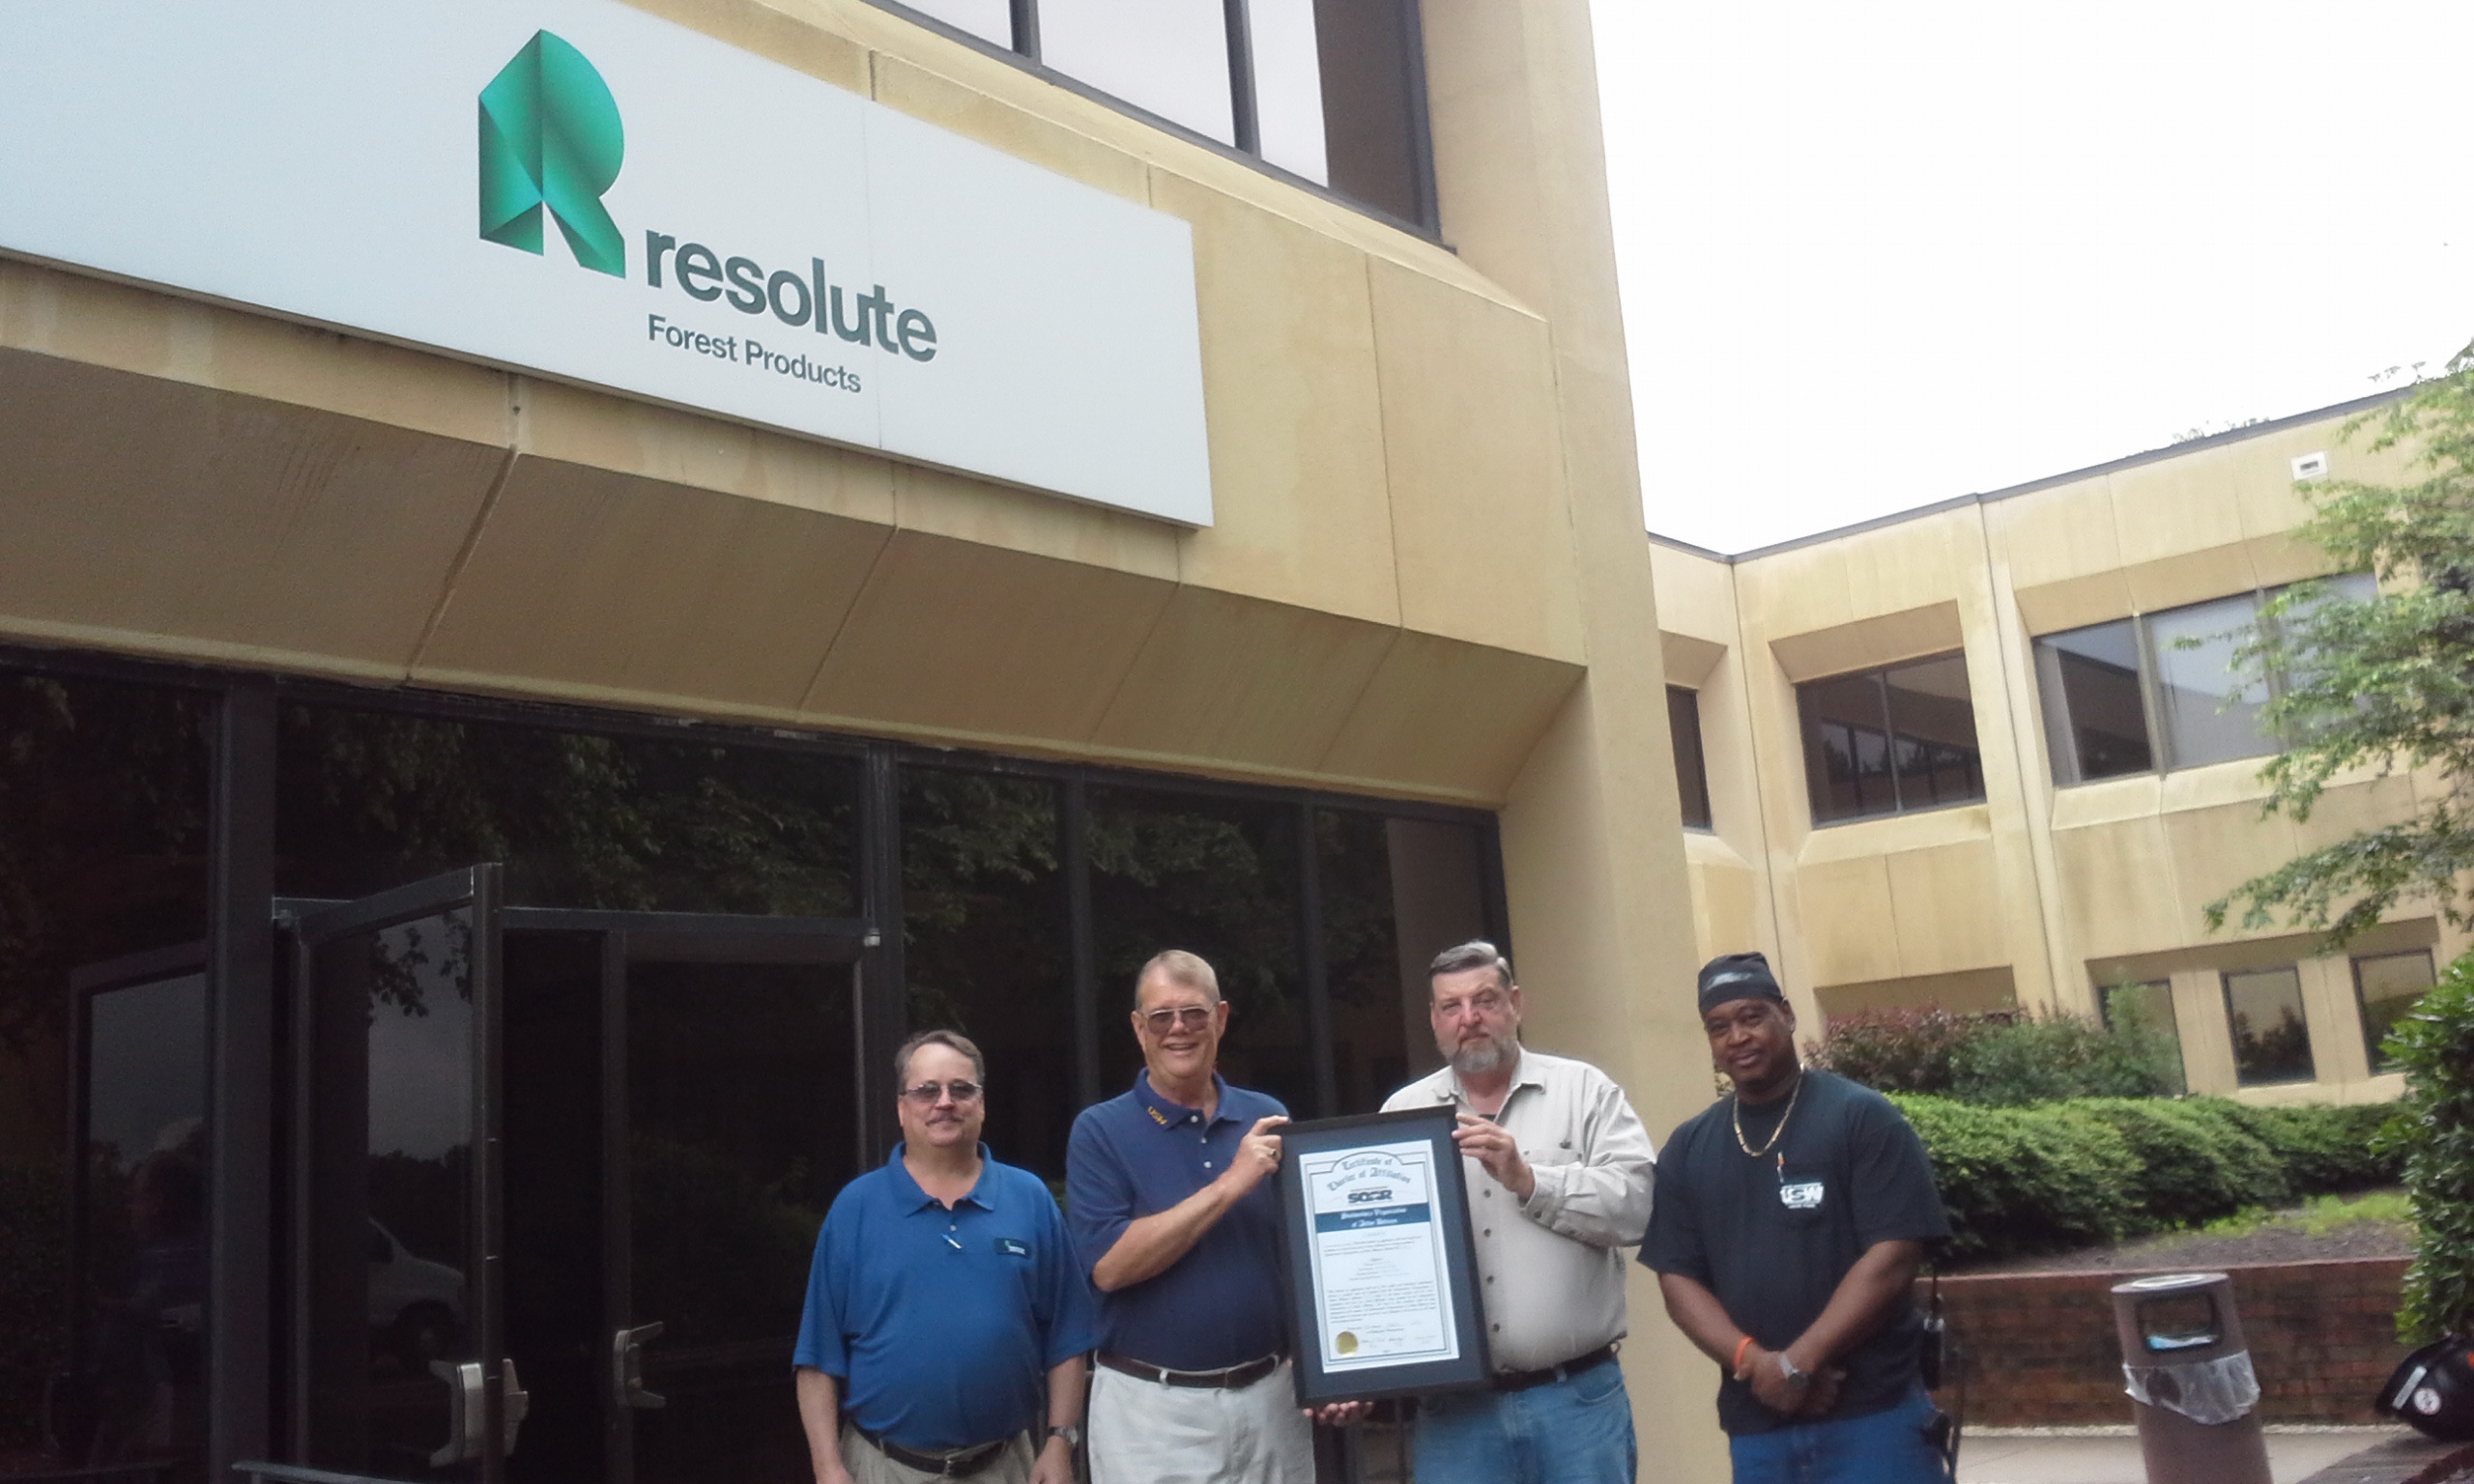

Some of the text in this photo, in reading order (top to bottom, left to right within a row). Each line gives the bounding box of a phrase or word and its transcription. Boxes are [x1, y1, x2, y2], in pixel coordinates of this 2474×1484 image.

[645, 228, 937, 363] resolute
[647, 313, 862, 394] Forest Products
